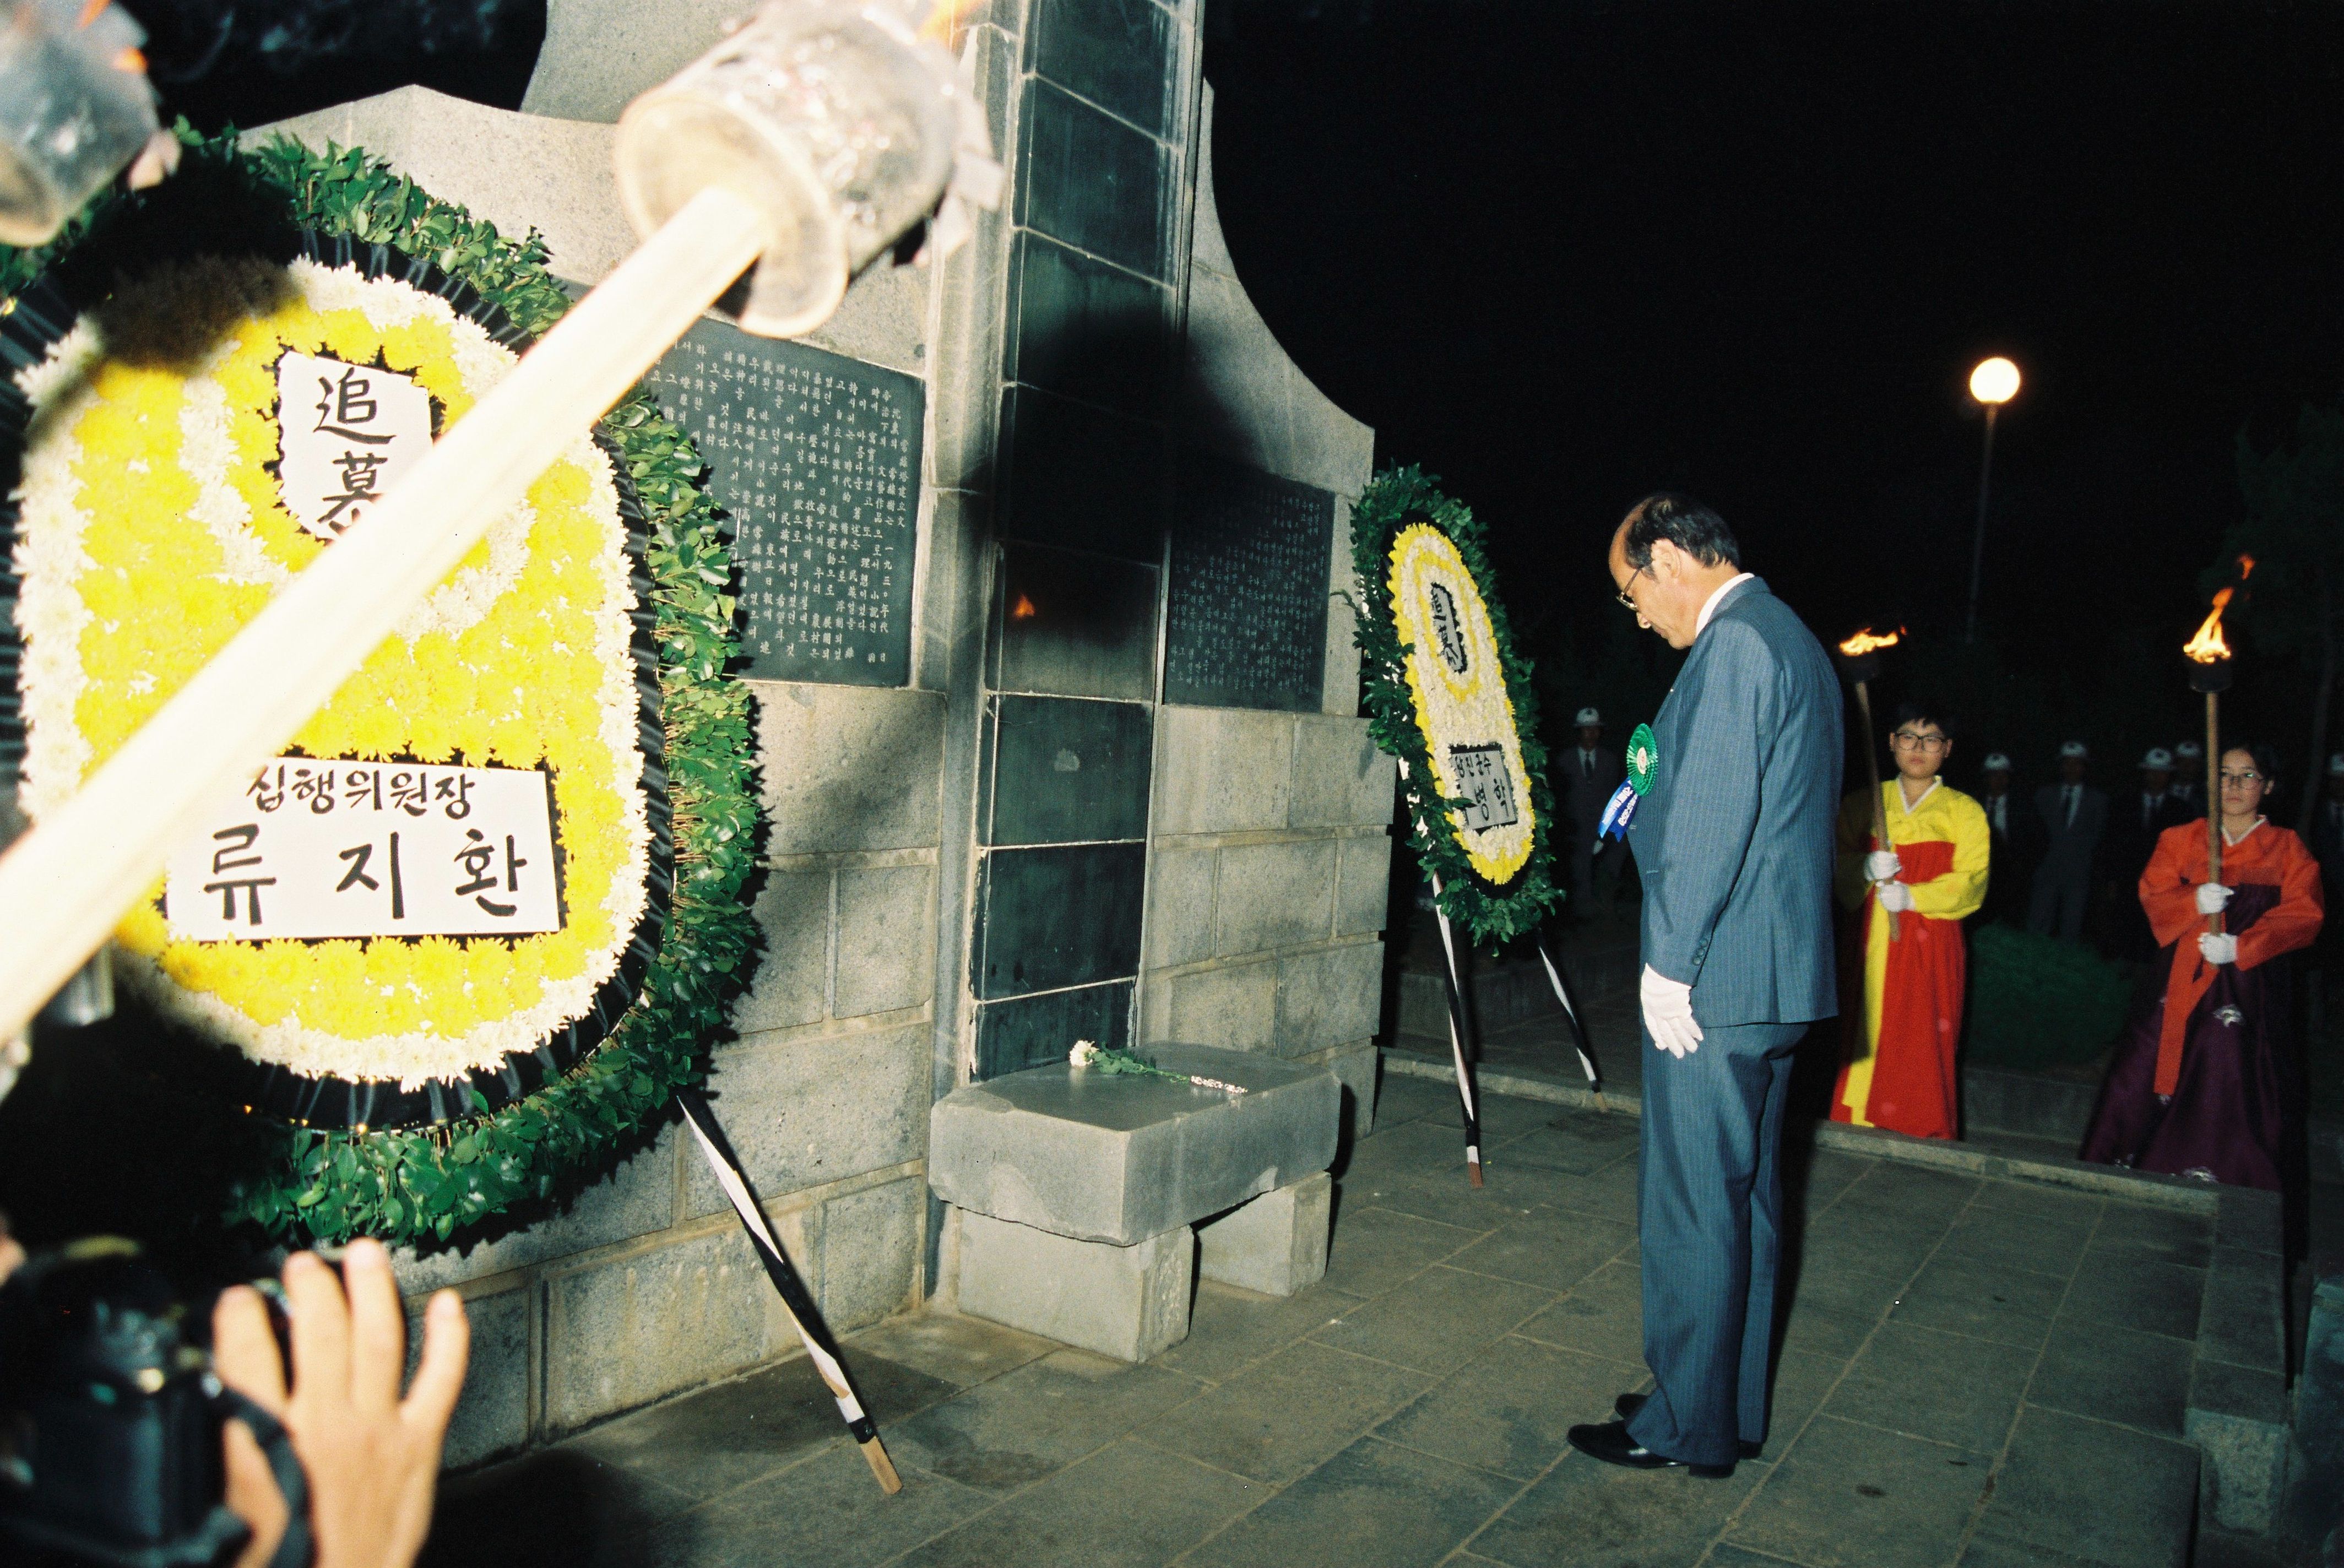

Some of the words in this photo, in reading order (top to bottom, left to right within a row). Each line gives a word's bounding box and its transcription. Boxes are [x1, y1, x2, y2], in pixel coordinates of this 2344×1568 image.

[748, 357, 759, 386] 우리
[718, 402, 729, 449] 것이다
[744, 406, 756, 471] 民族에게
[820, 422, 829, 466] 것이다
[782, 462, 792, 491] 우리
[854, 430, 865, 490] 아름다운
[767, 493, 775, 523] 것이
[778, 512, 790, 574] 民族에게
[813, 566, 824, 594] 우리
